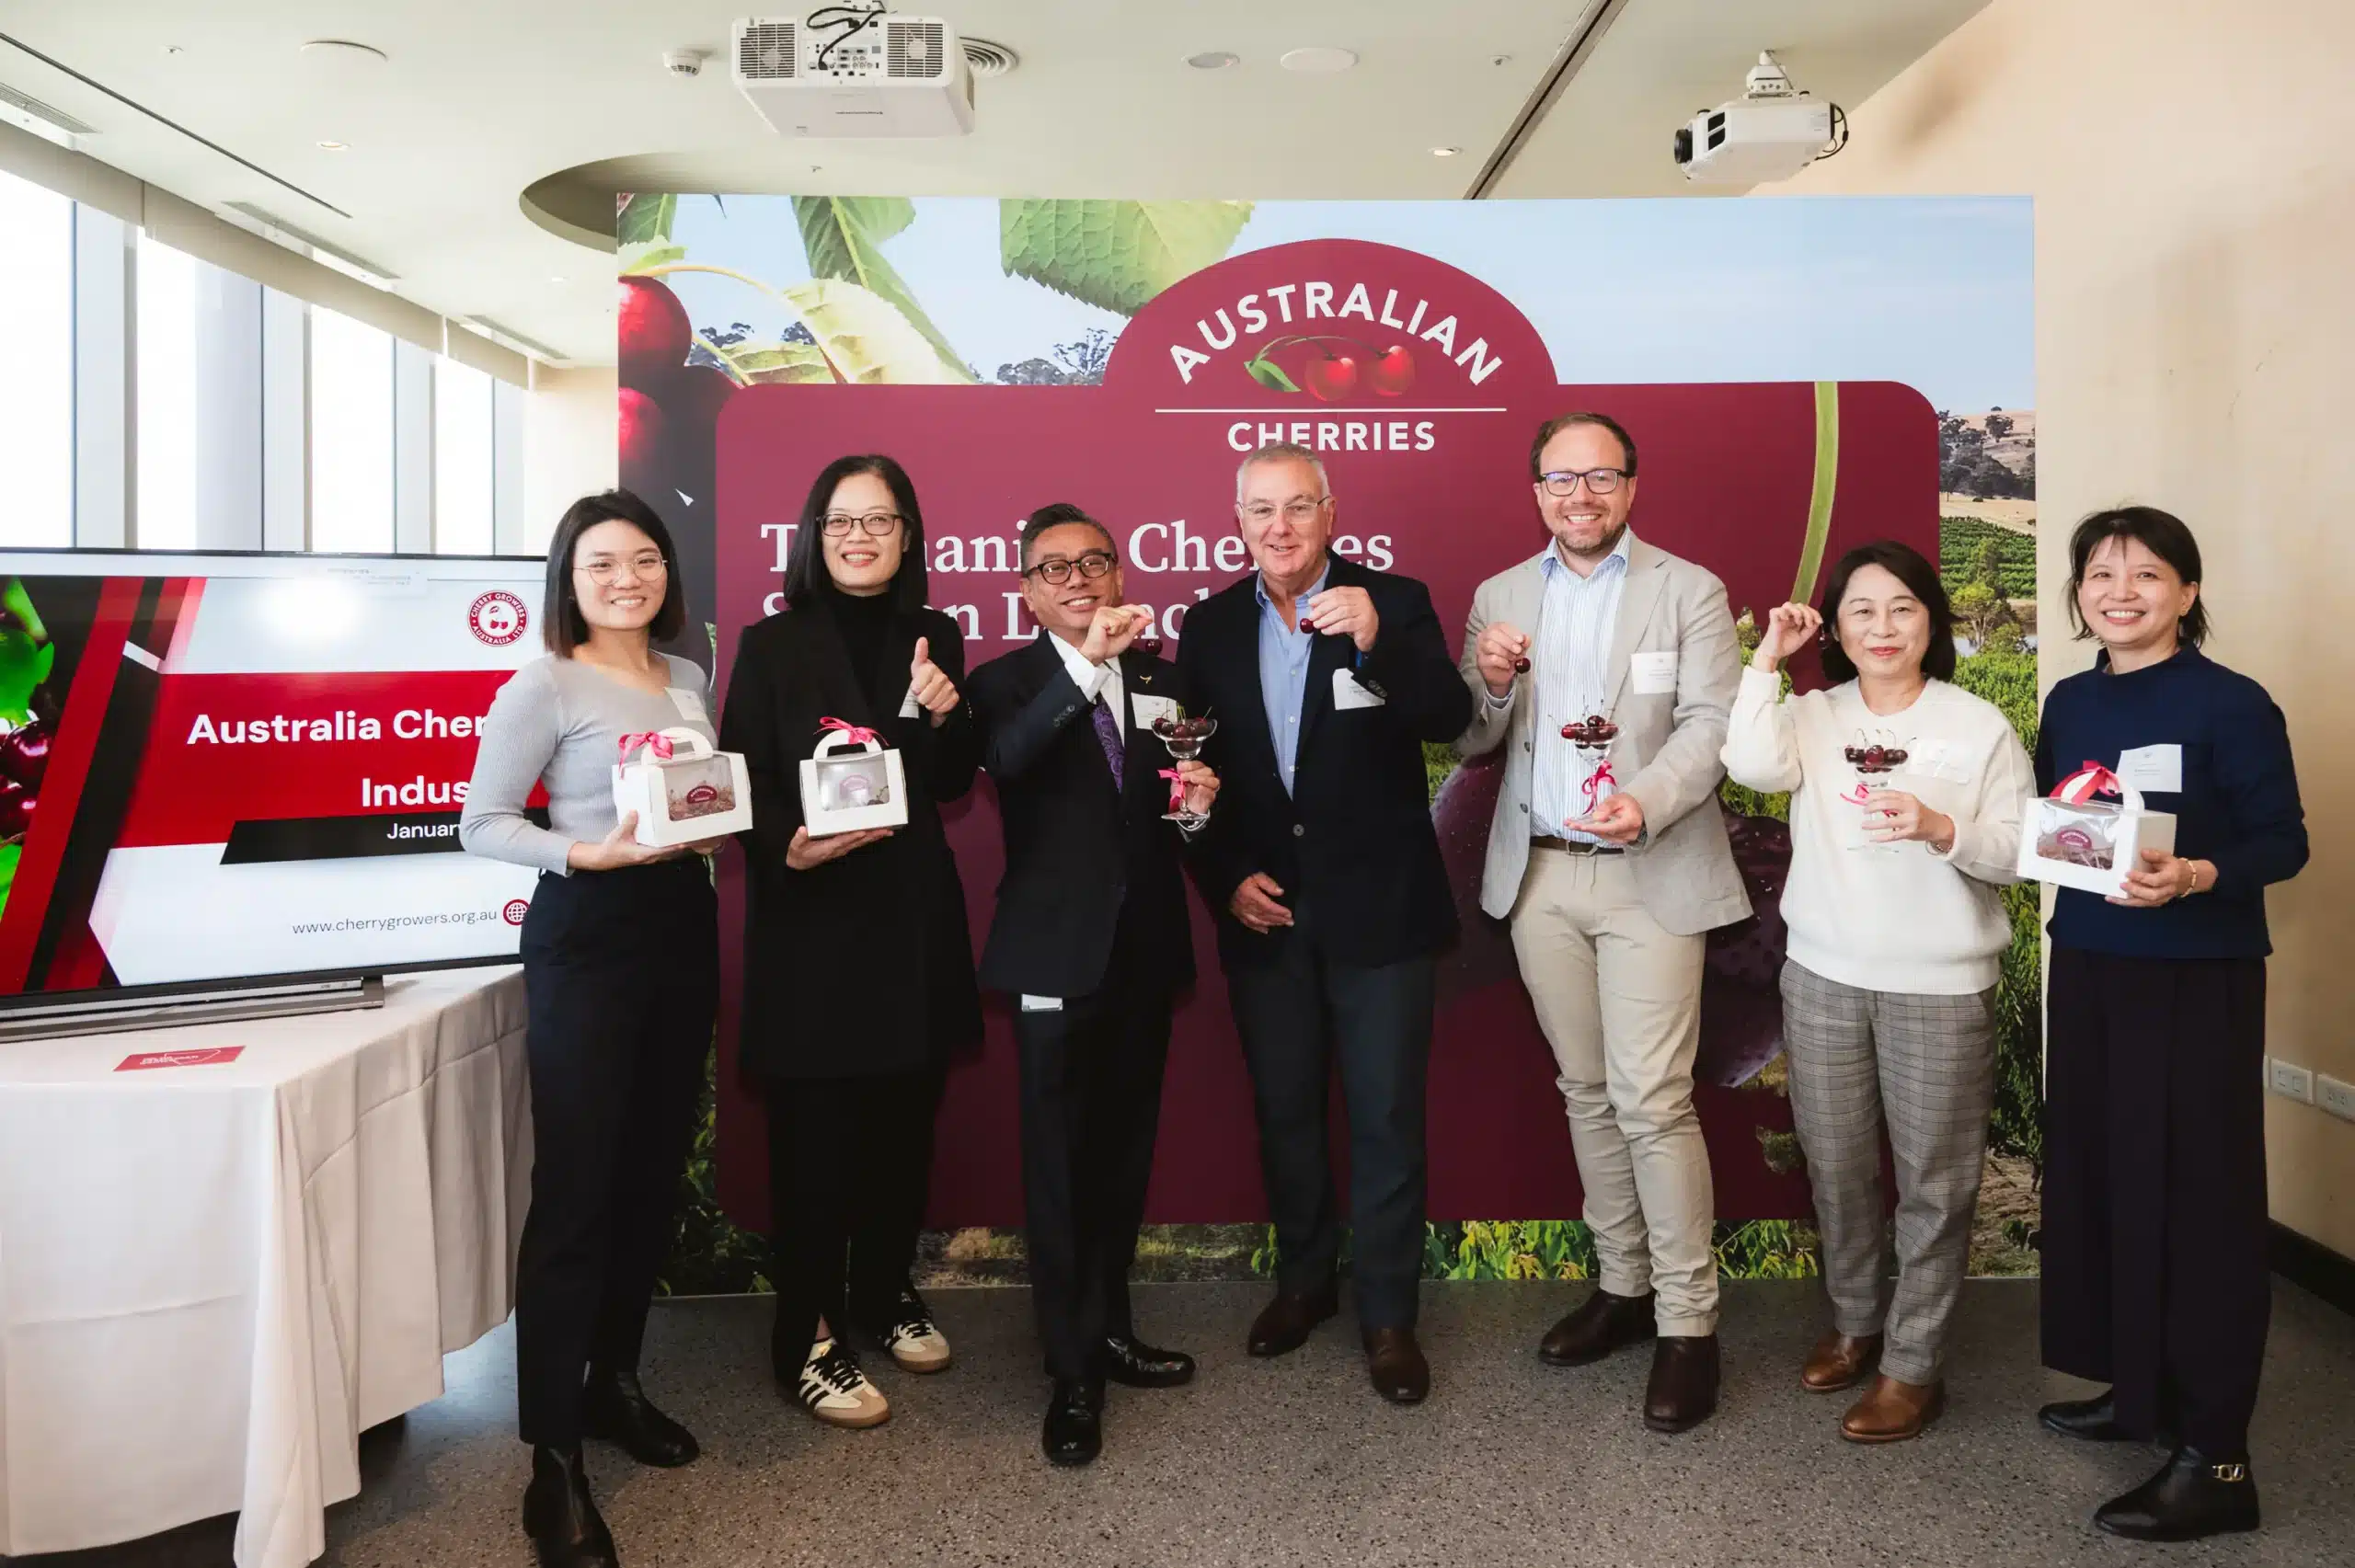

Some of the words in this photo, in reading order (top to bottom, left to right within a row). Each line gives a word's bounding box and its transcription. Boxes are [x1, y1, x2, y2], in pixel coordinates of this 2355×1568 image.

[1169, 281, 1502, 385] AUSTRALIAN
[1227, 421, 1435, 452] CHERRIES
[1129, 520, 1394, 572] Chees
[471, 594, 492, 618] CHERRY
[495, 593, 525, 618] GROWERS
[472, 625, 511, 644] AUSTRALIA
[512, 625, 523, 638] LTD
[187, 710, 382, 745] Australia
[393, 709, 487, 738] Cher
[362, 775, 470, 807] Indus
[386, 823, 460, 840] Januar
[293, 910, 497, 934] www.cherrygrowers.org.au
